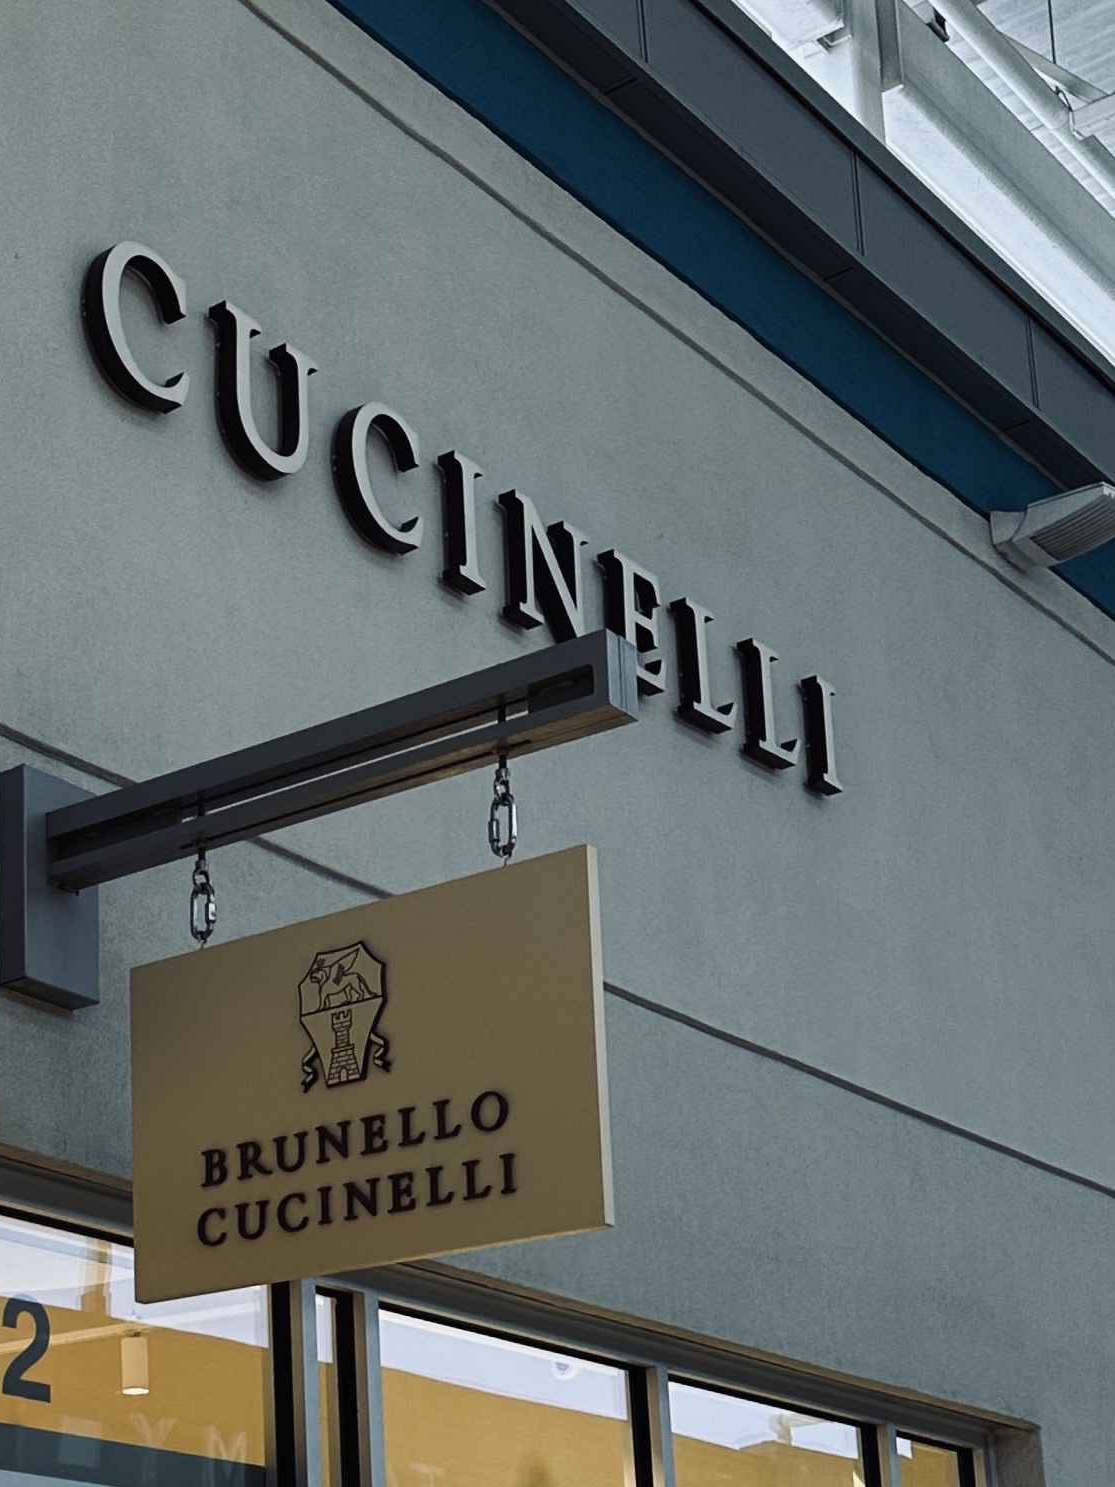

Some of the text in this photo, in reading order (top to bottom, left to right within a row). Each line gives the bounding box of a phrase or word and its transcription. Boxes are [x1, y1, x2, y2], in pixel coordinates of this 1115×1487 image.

[84, 240, 844, 796] CUCINELLI
[200, 1090, 510, 1188] BRUNELLO
[197, 1152, 517, 1247] CUCINELLI
